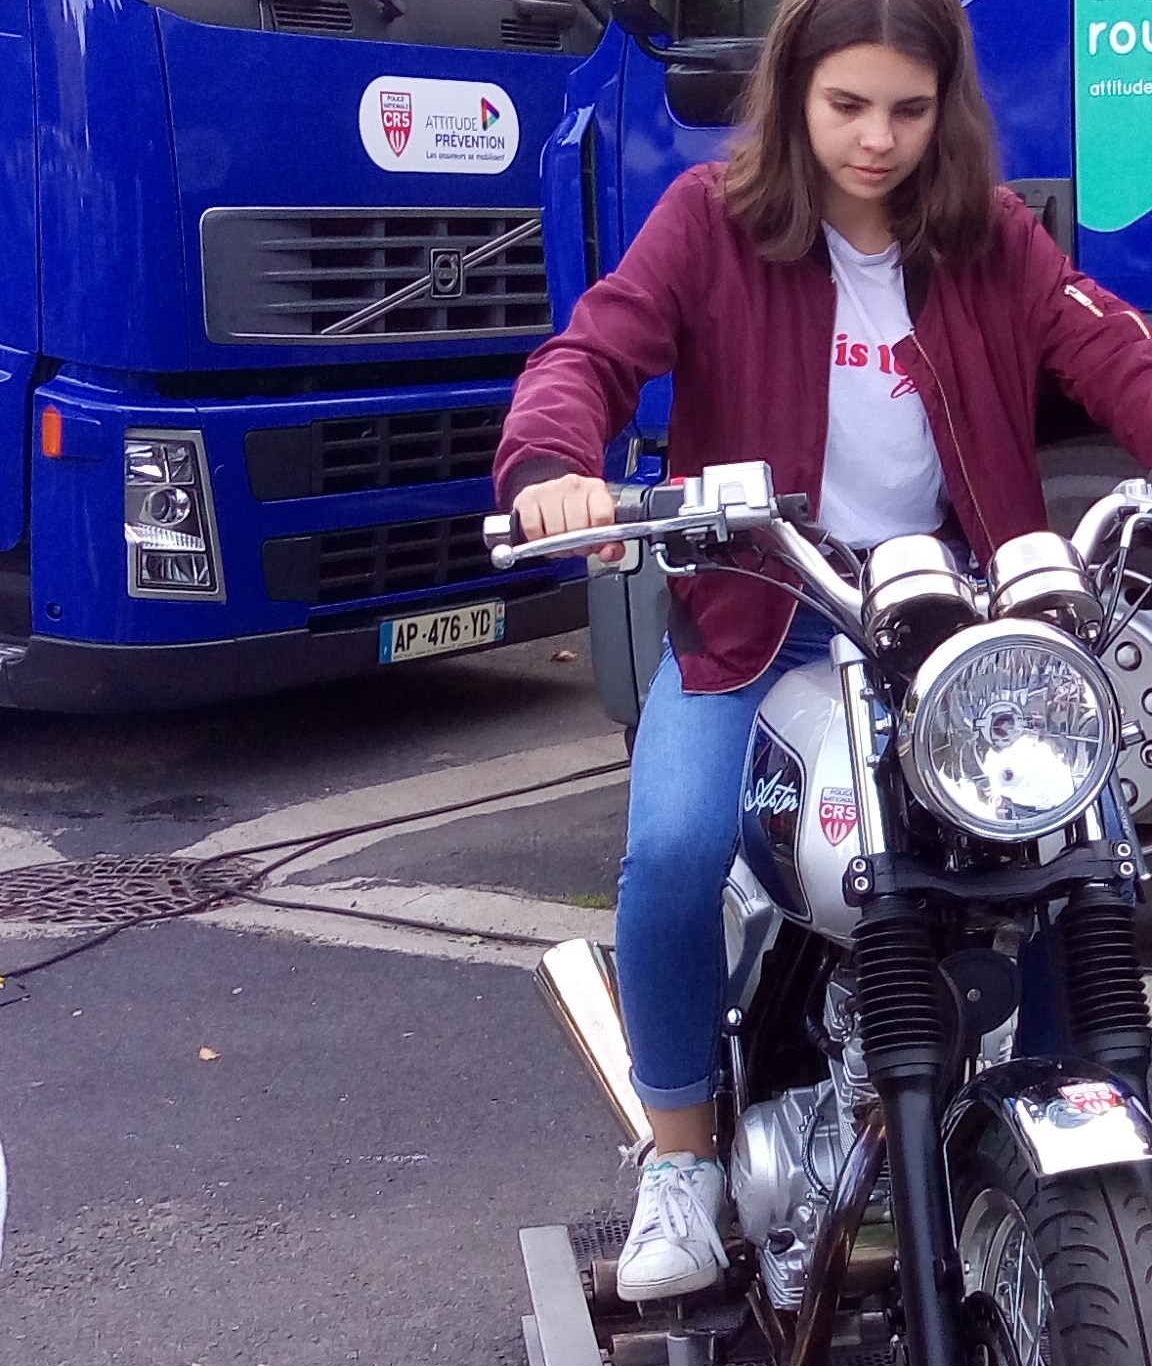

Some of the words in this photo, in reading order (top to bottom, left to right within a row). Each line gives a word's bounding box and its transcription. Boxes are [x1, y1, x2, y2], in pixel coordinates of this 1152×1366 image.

[383, 111, 411, 128] CRS
[425, 115, 479, 132] ATTITUDE
[435, 131, 506, 150] PRÉVENTION
[834, 333, 869, 368] is
[820, 803, 857, 821] CRS
